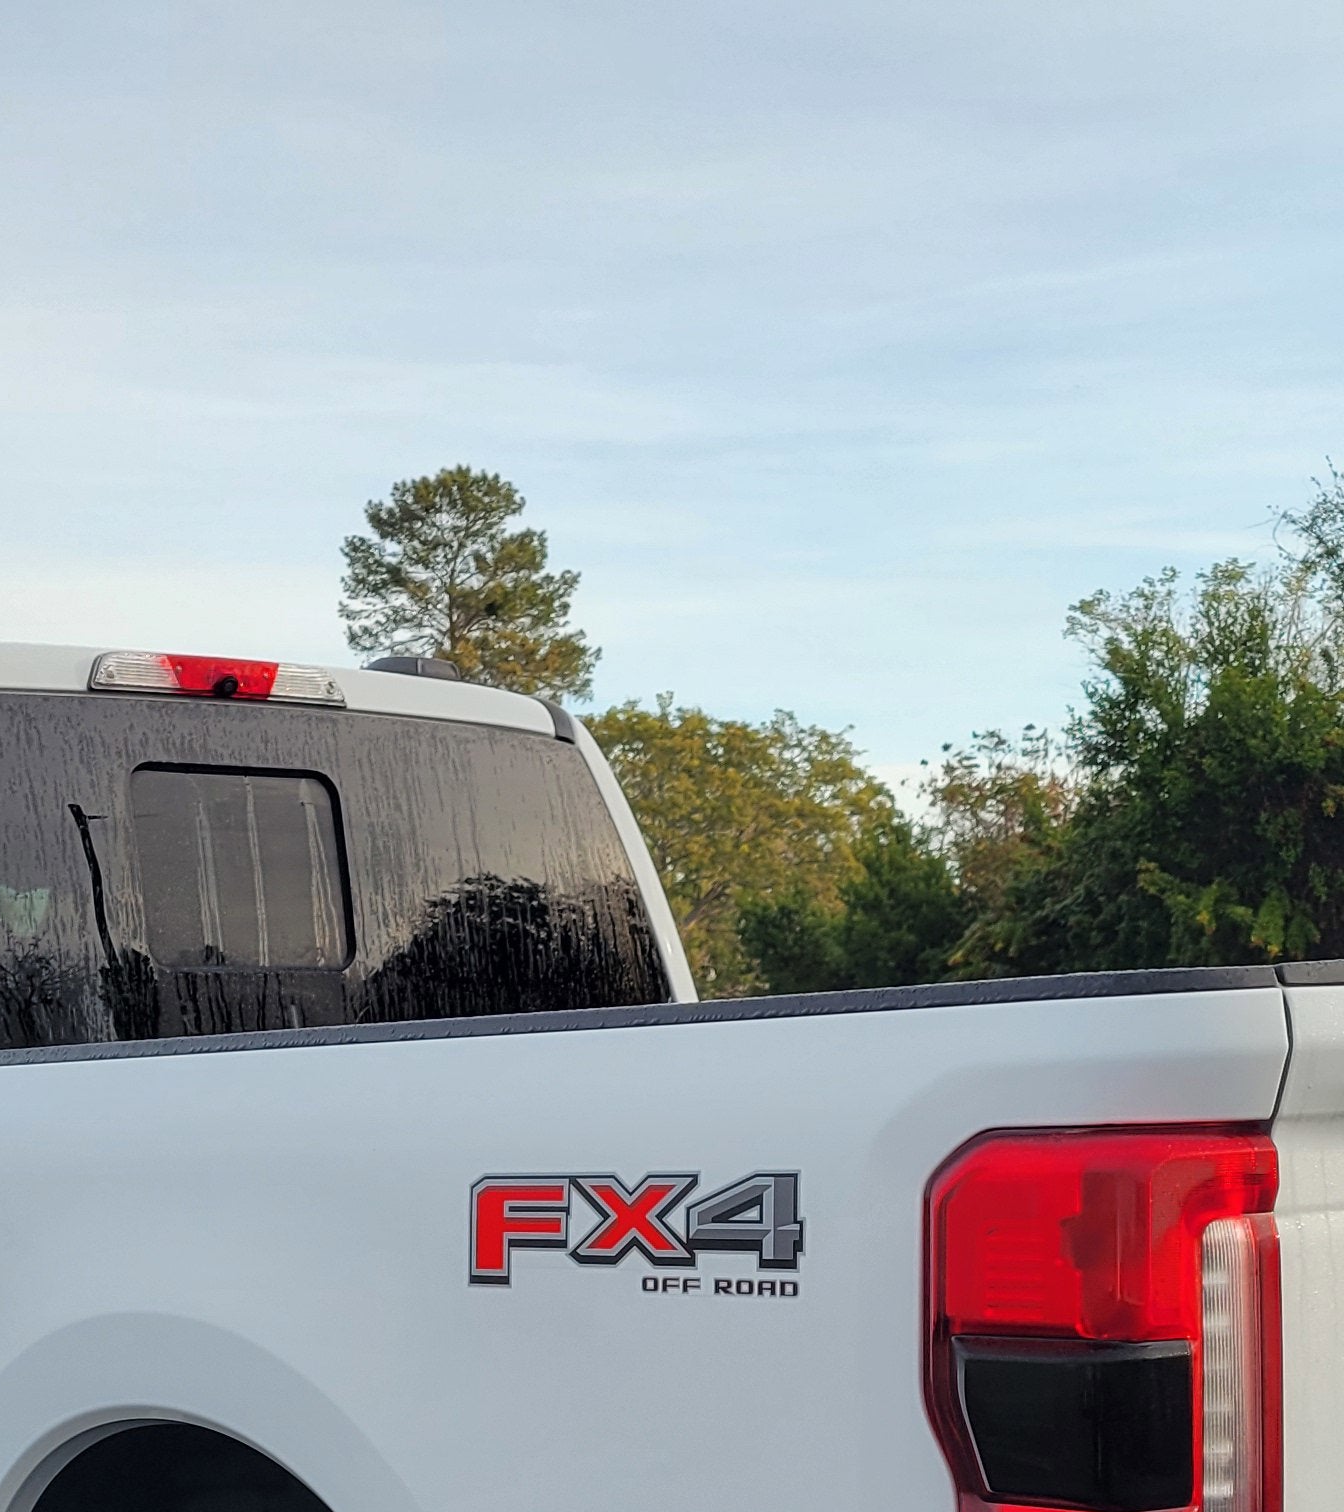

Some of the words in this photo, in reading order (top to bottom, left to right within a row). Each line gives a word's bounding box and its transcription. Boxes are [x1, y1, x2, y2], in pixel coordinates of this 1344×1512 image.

[468, 1172, 805, 1286] FX4
[641, 1276, 701, 1294] OFF
[713, 1278, 798, 1298] ROAD
